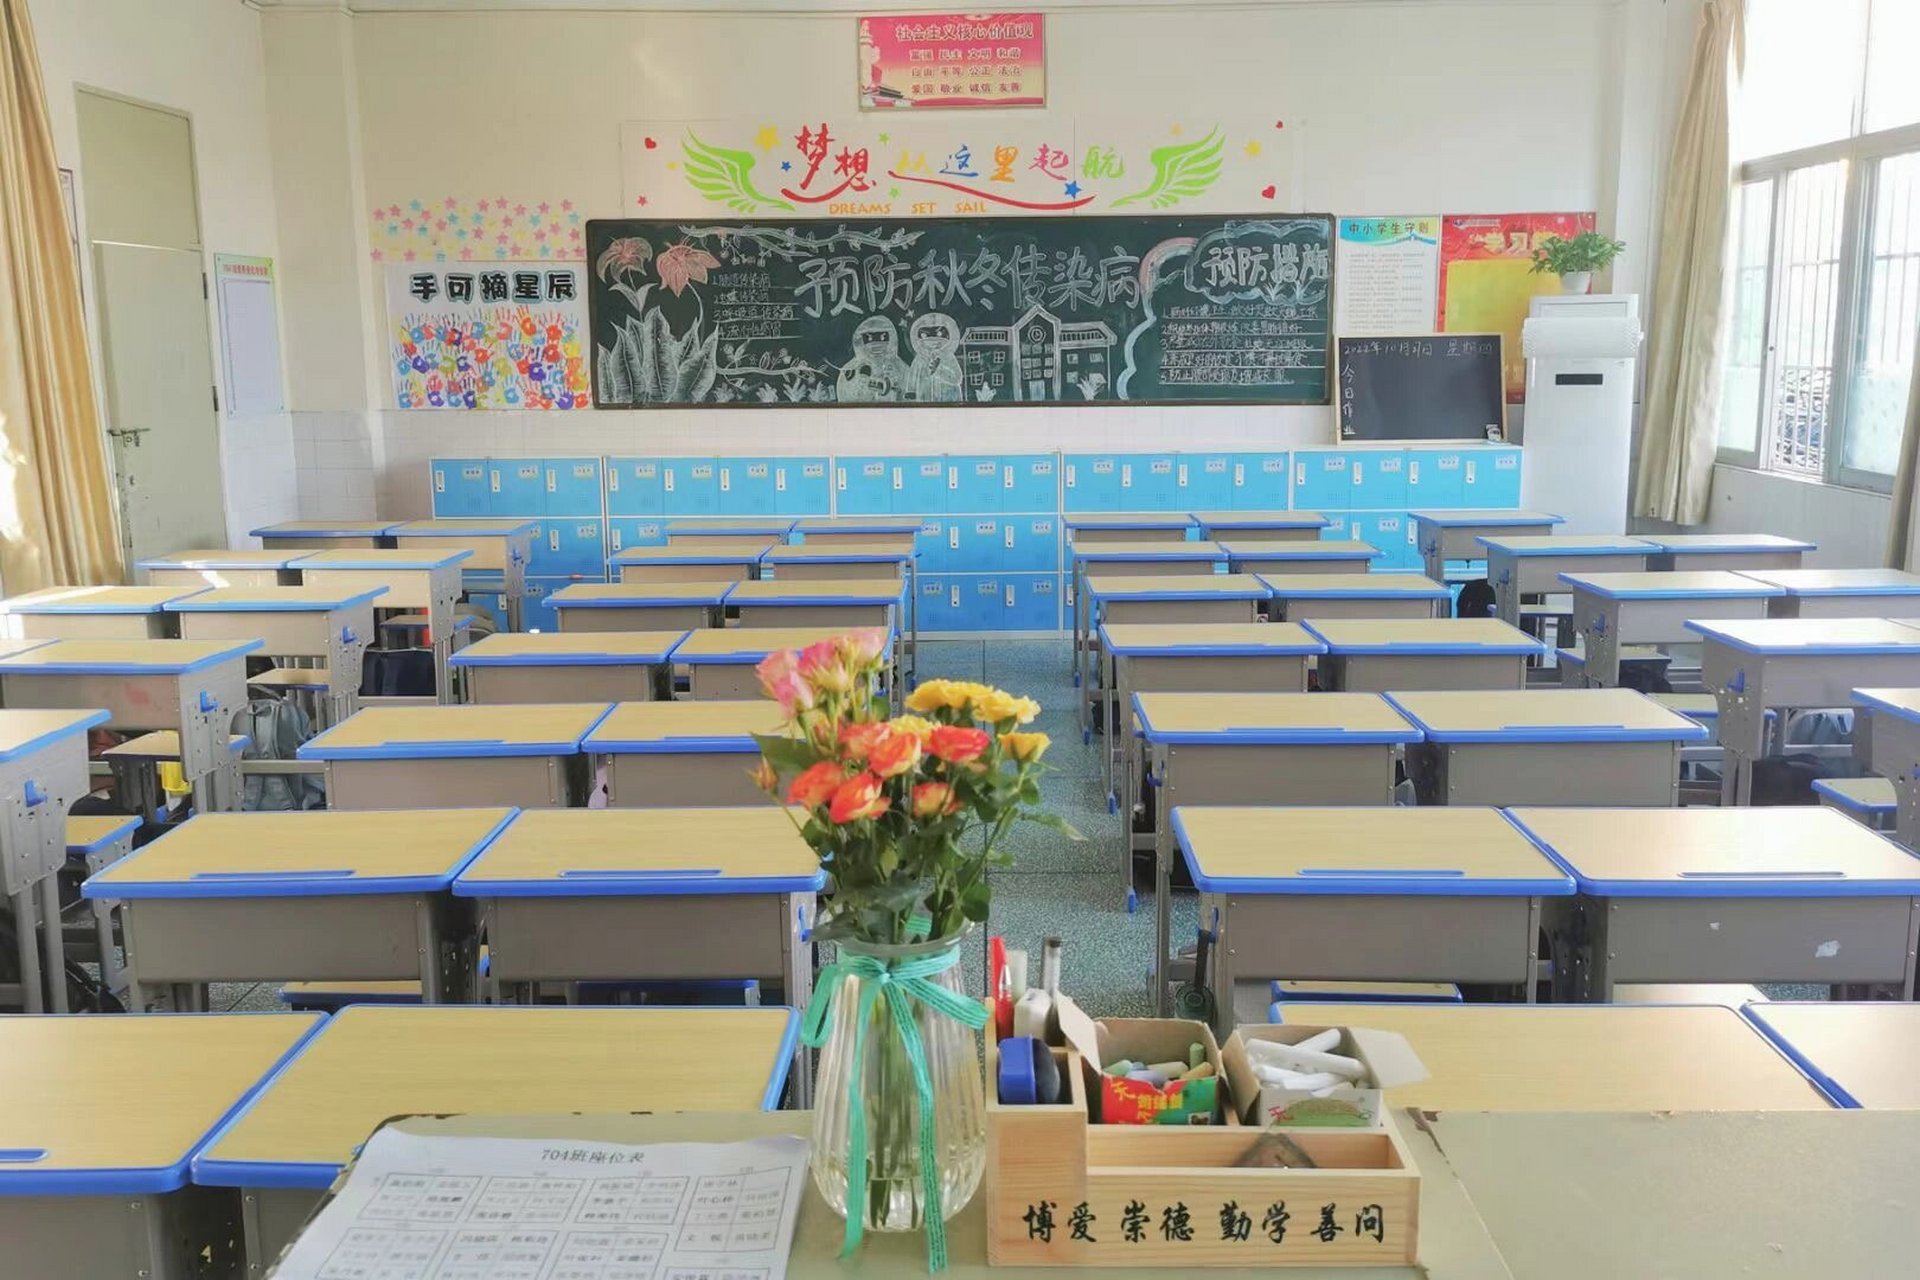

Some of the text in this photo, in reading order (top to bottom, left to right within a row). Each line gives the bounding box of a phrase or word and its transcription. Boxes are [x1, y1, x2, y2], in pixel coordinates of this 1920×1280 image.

[968, 48, 992, 59] 文明
[969, 65, 991, 76] 公正
[795, 123, 1125, 192] 梦想 从这里起航
[829, 202, 987, 215] DREAMS SET SAIL
[1349, 221, 1430, 235] 中小学生守则
[411, 272, 574, 302] 手可摘星辰
[794, 244, 1141, 318] 预防秋冬传染病
[1022, 1200, 1385, 1244] 博爱 崇德 勤学 善问
